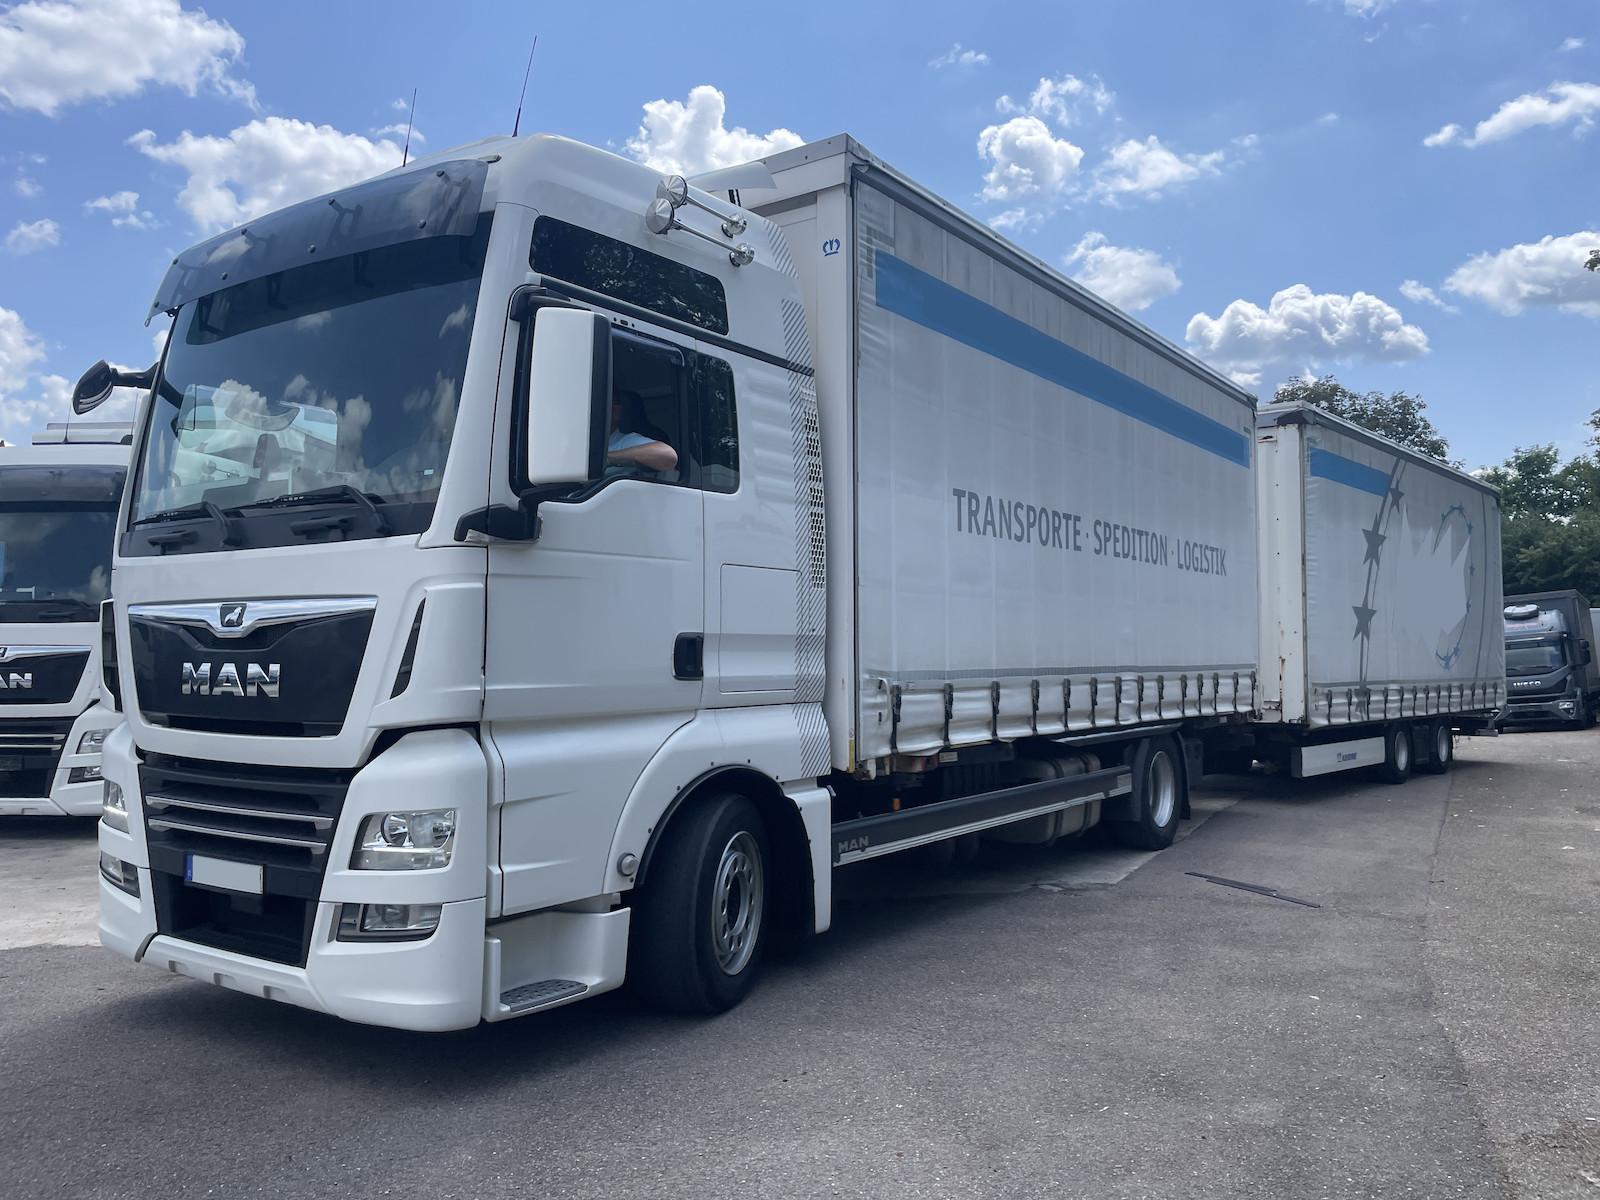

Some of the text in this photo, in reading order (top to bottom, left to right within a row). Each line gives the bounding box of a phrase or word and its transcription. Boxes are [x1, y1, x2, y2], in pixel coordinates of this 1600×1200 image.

[952, 487, 1227, 577] TRANSPORTE SPEDITION LOGISTIK
[181, 662, 281, 698] MAN
[838, 836, 869, 853] MAN
